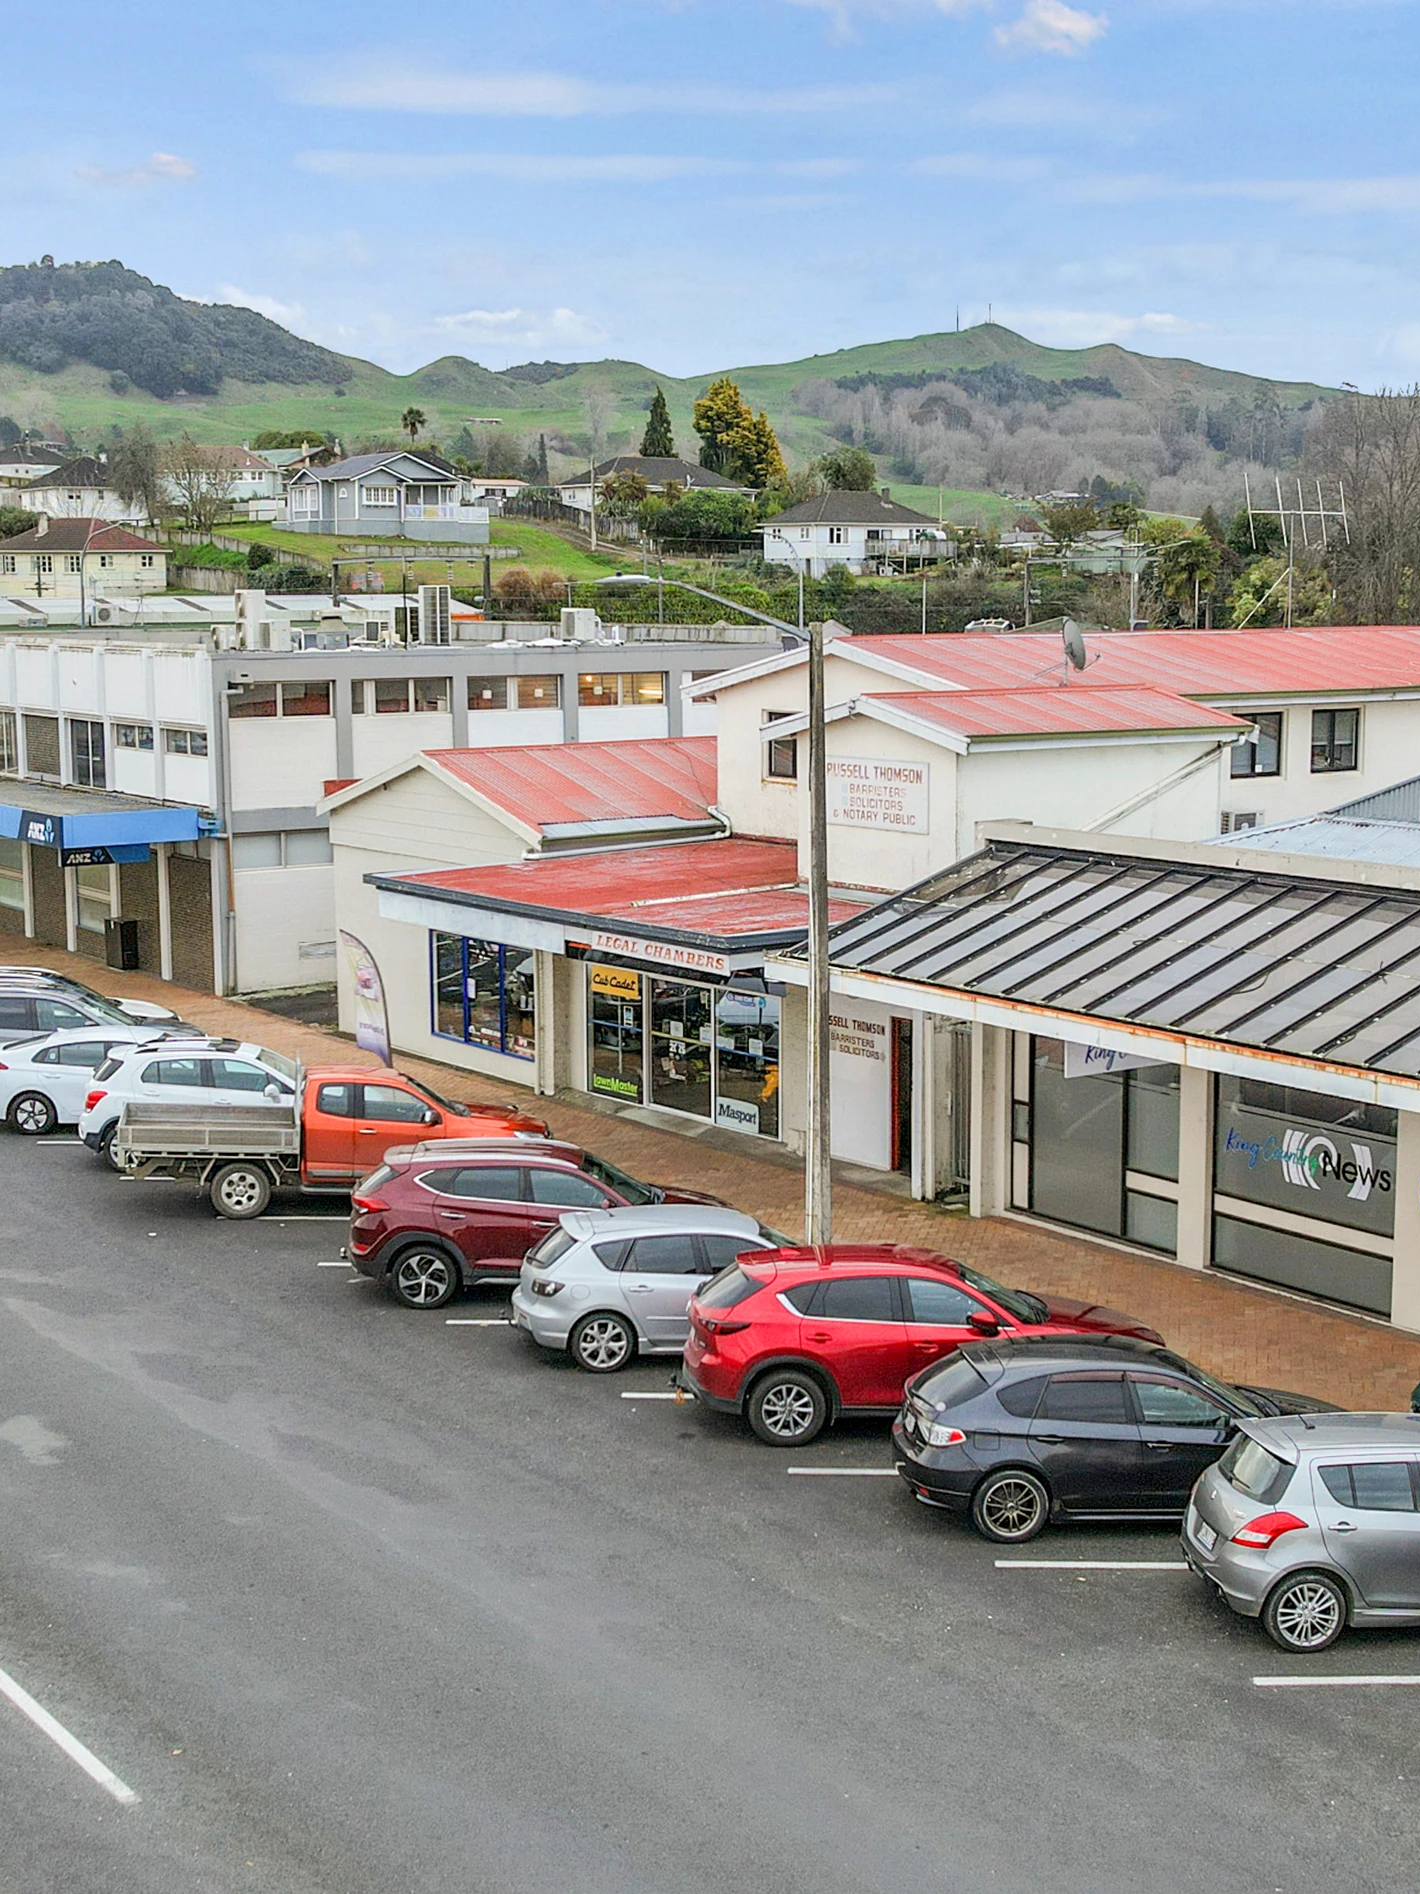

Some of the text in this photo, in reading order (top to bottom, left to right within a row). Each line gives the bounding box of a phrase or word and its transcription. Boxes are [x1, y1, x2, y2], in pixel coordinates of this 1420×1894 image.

[873, 766, 923, 784] THOMSON
[849, 796, 904, 811] SOLICITORS
[843, 809, 879, 822] NOTARY
[883, 812, 916, 825] PUBLIC
[27, 821, 46, 842] ANZ
[66, 853, 92, 864] ANZ
[596, 935, 726, 970] LEGAL CHAMBERS
[593, 973, 637, 992] Cub Cadet
[852, 1019, 886, 1036] THOMSON
[831, 1032, 875, 1048] BARRISTERS
[839, 1044, 880, 1060] SOLICITORS
[719, 1103, 757, 1125] Masport
[1225, 1127, 1392, 1192] King Country News
